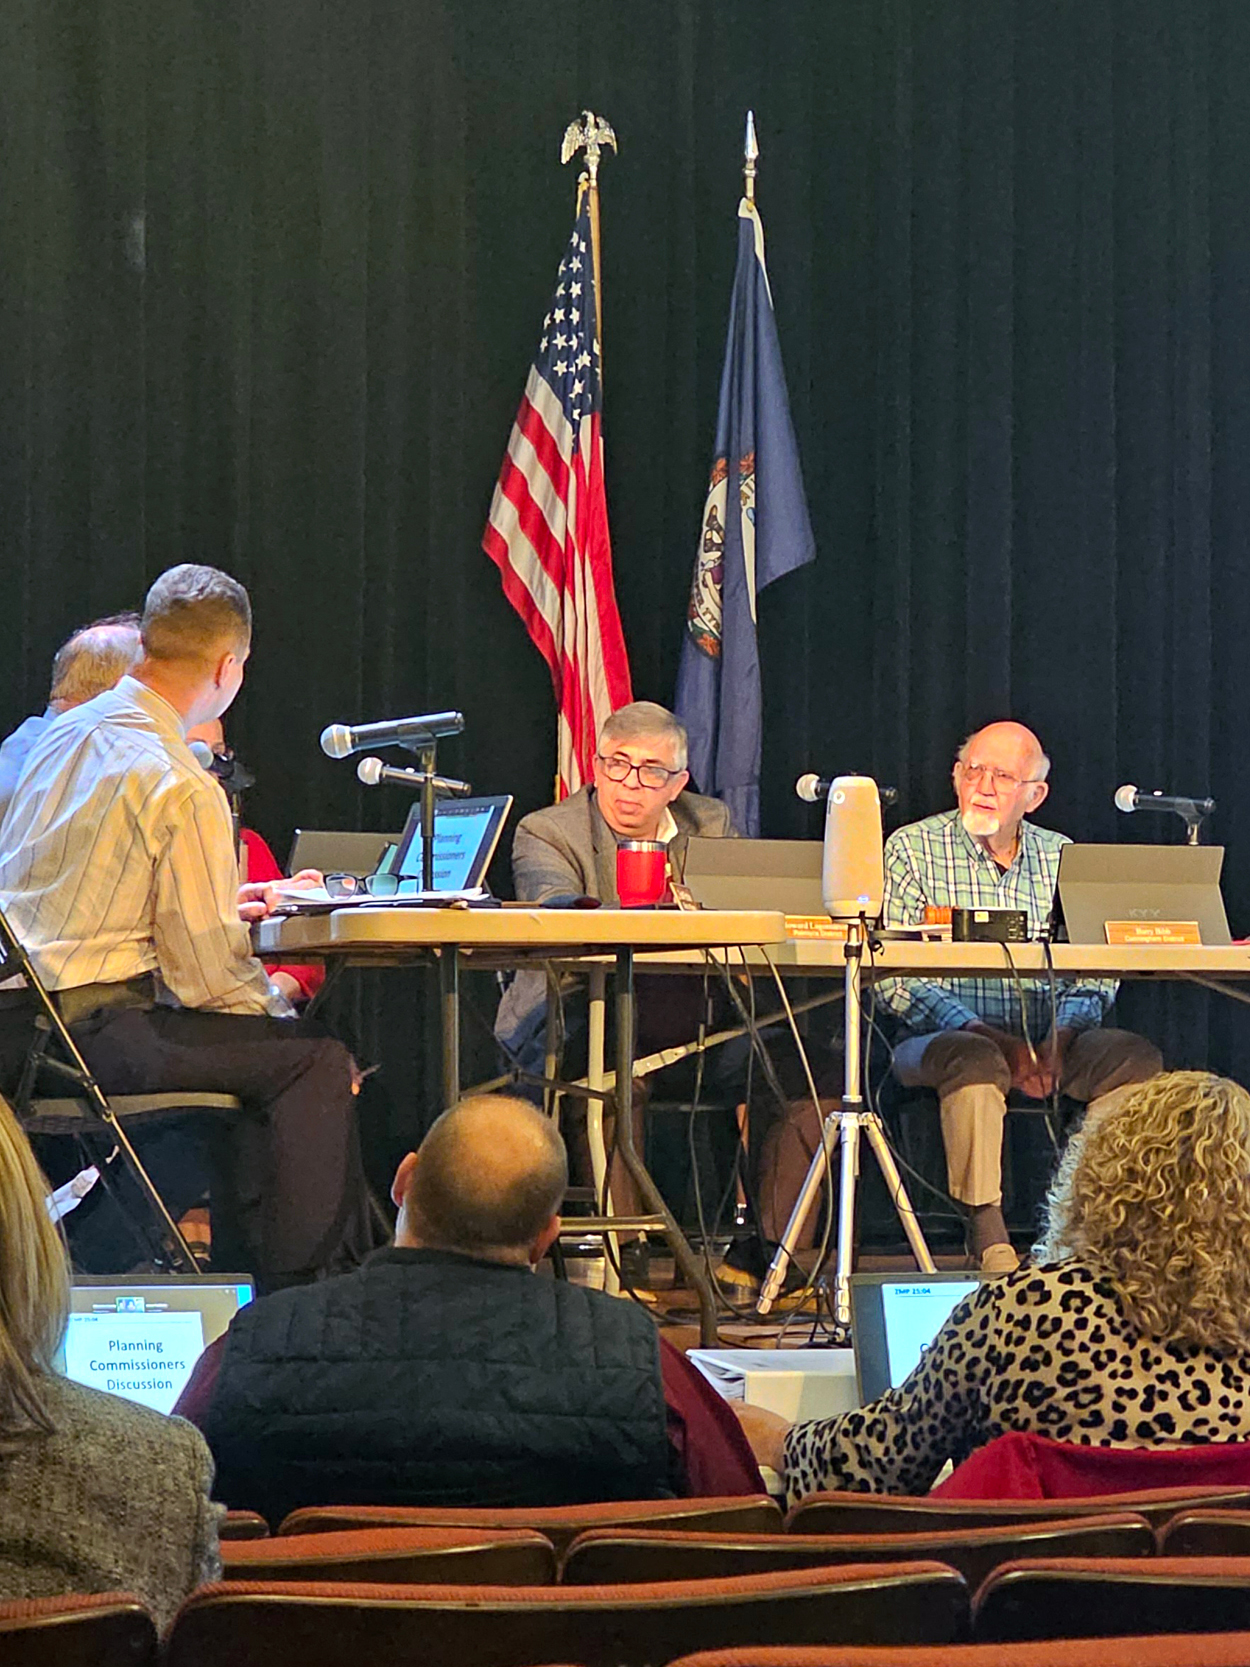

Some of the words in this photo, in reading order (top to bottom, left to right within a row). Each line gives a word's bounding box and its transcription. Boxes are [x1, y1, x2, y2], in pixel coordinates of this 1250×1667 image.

[108, 1340, 164, 1353] Planning
[89, 1359, 186, 1371] Commissioners
[107, 1378, 173, 1391] Discussion
